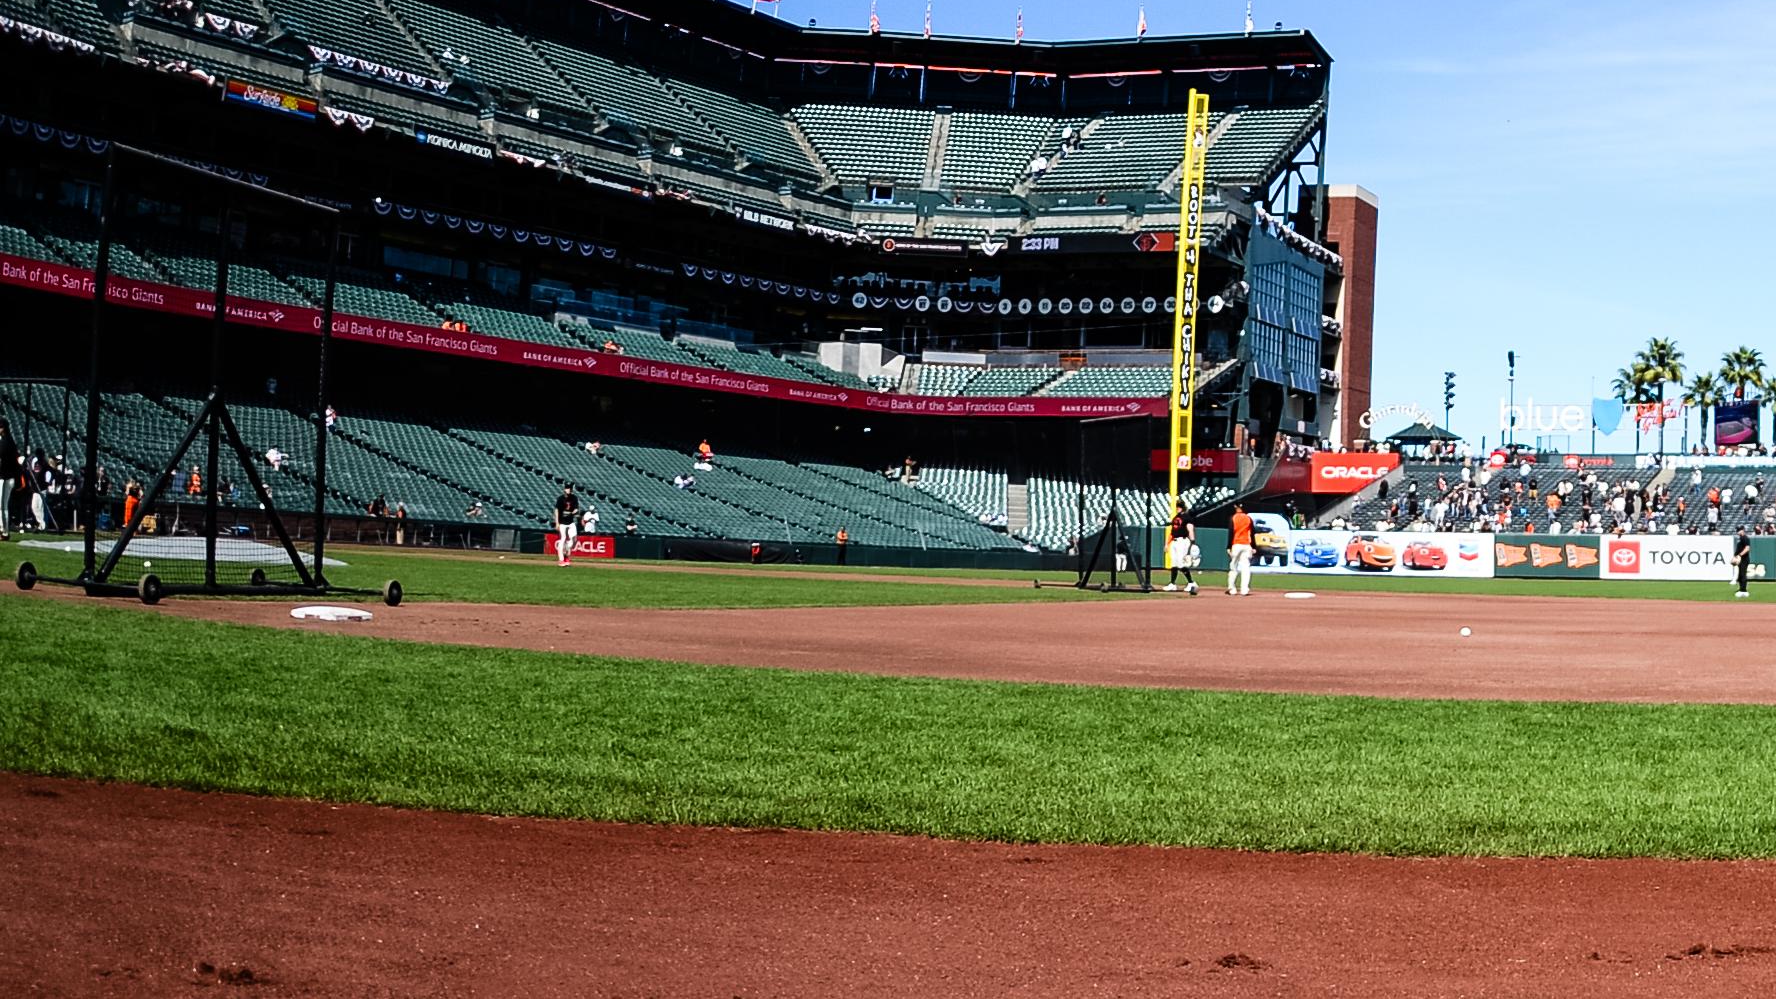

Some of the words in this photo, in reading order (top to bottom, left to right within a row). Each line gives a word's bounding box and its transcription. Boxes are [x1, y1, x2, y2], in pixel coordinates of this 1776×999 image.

[427, 134, 458, 150] KONICA
[458, 142, 493, 159] MINOLTA
[1043, 237, 1059, 250] PM
[2, 262, 27, 280] Bank
[30, 266, 41, 282] of
[42, 270, 60, 287] the
[63, 275, 81, 290] San
[132, 287, 164, 305] Giants
[313, 316, 348, 333] Ocial
[350, 322, 374, 337] Bank
[376, 326, 387, 340] of
[388, 327, 404, 342] the
[406, 331, 424, 345] San
[425, 333, 468, 351] Francisco
[470, 340, 498, 355] Giants
[620, 361, 649, 377] Official
[650, 365, 669, 379] Bank
[670, 368, 680, 381] of
[681, 370, 693, 383] the
[696, 373, 710, 385] San
[711, 375, 745, 389] Francisco
[746, 379, 769, 393] Giants
[891, 398, 913, 410] Bank
[916, 399, 927, 410] of
[929, 400, 945, 411] the
[947, 400, 964, 412] San
[965, 401, 1006, 413] Francisco
[1007, 401, 1035, 412] Giants
[1061, 404, 1080, 412] BANK
[1092, 404, 1125, 412] AMERICA
[1499, 396, 1585, 433] blue
[1648, 550, 1726, 565] TOYOTA
